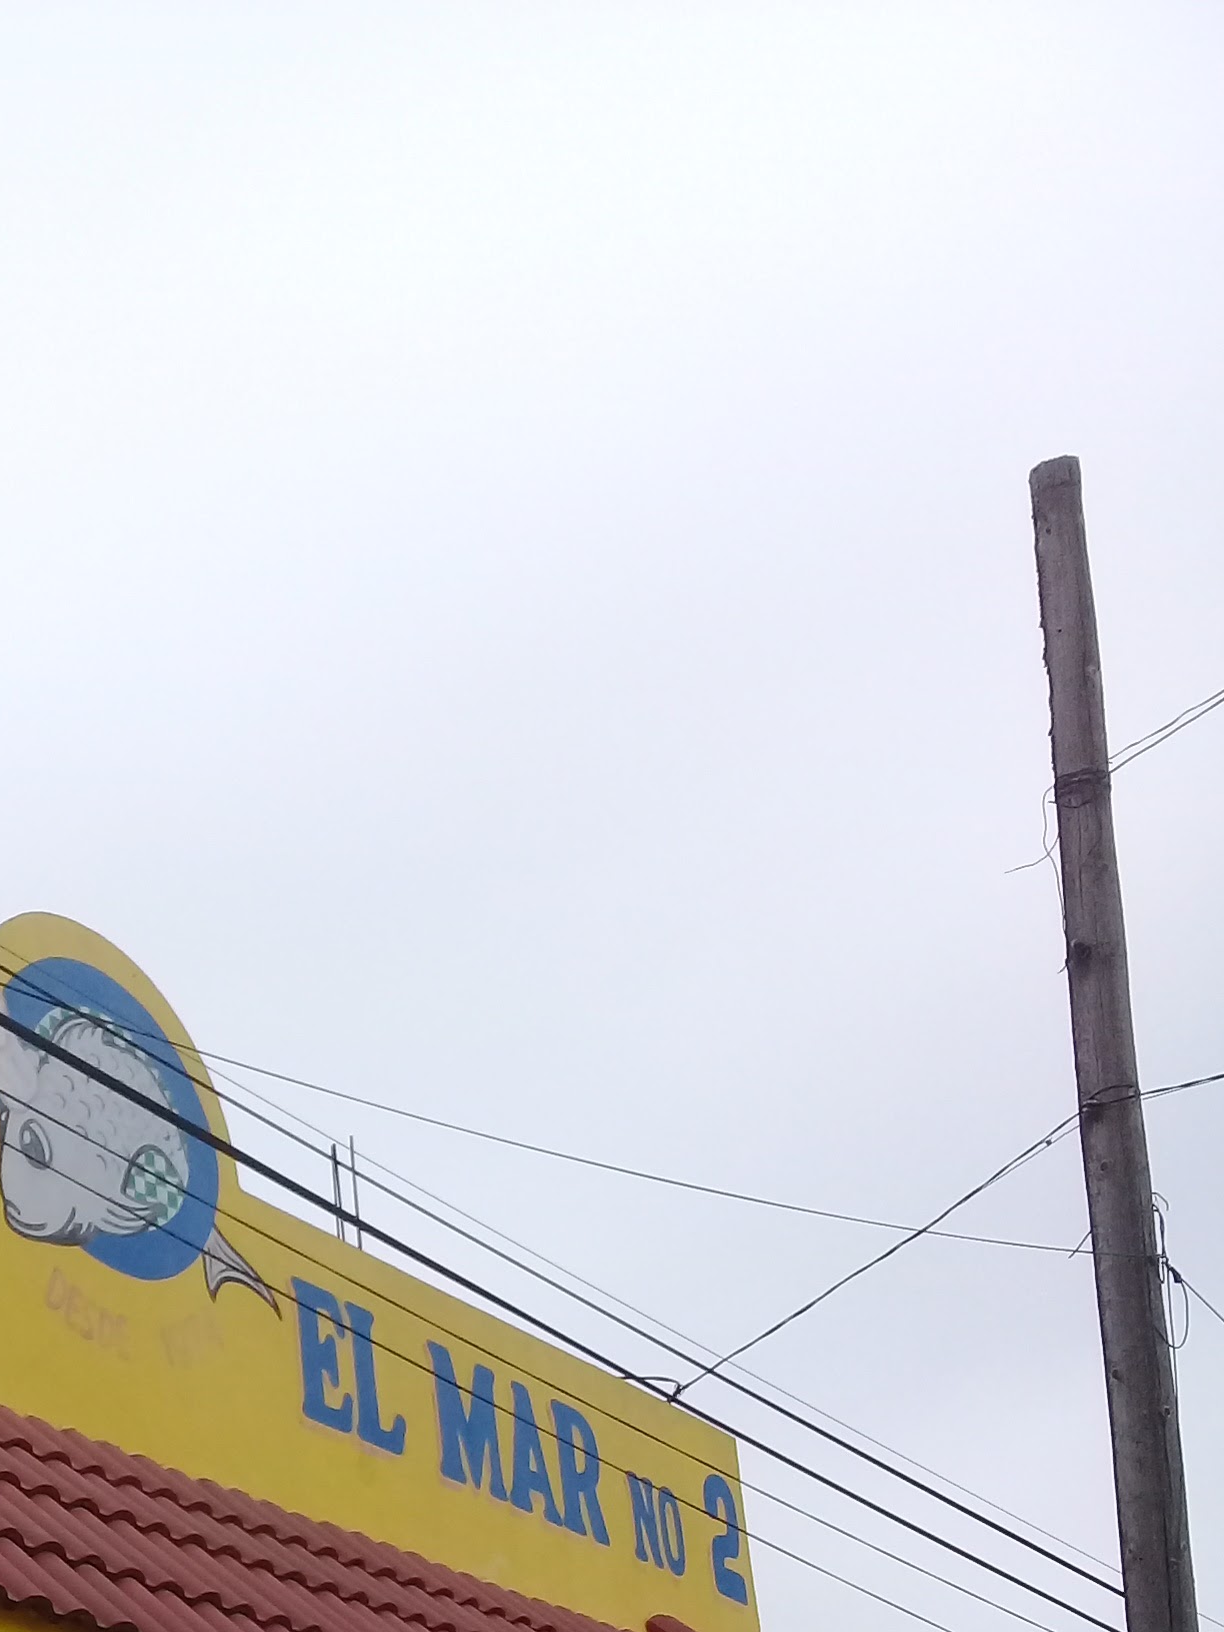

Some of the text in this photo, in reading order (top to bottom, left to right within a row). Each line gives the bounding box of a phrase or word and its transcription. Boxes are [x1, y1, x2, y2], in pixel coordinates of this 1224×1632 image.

[290, 1276, 407, 1456] EL
[426, 1340, 611, 1547] MAR
[626, 1471, 687, 1577] NO
[702, 1473, 749, 1606] 2
